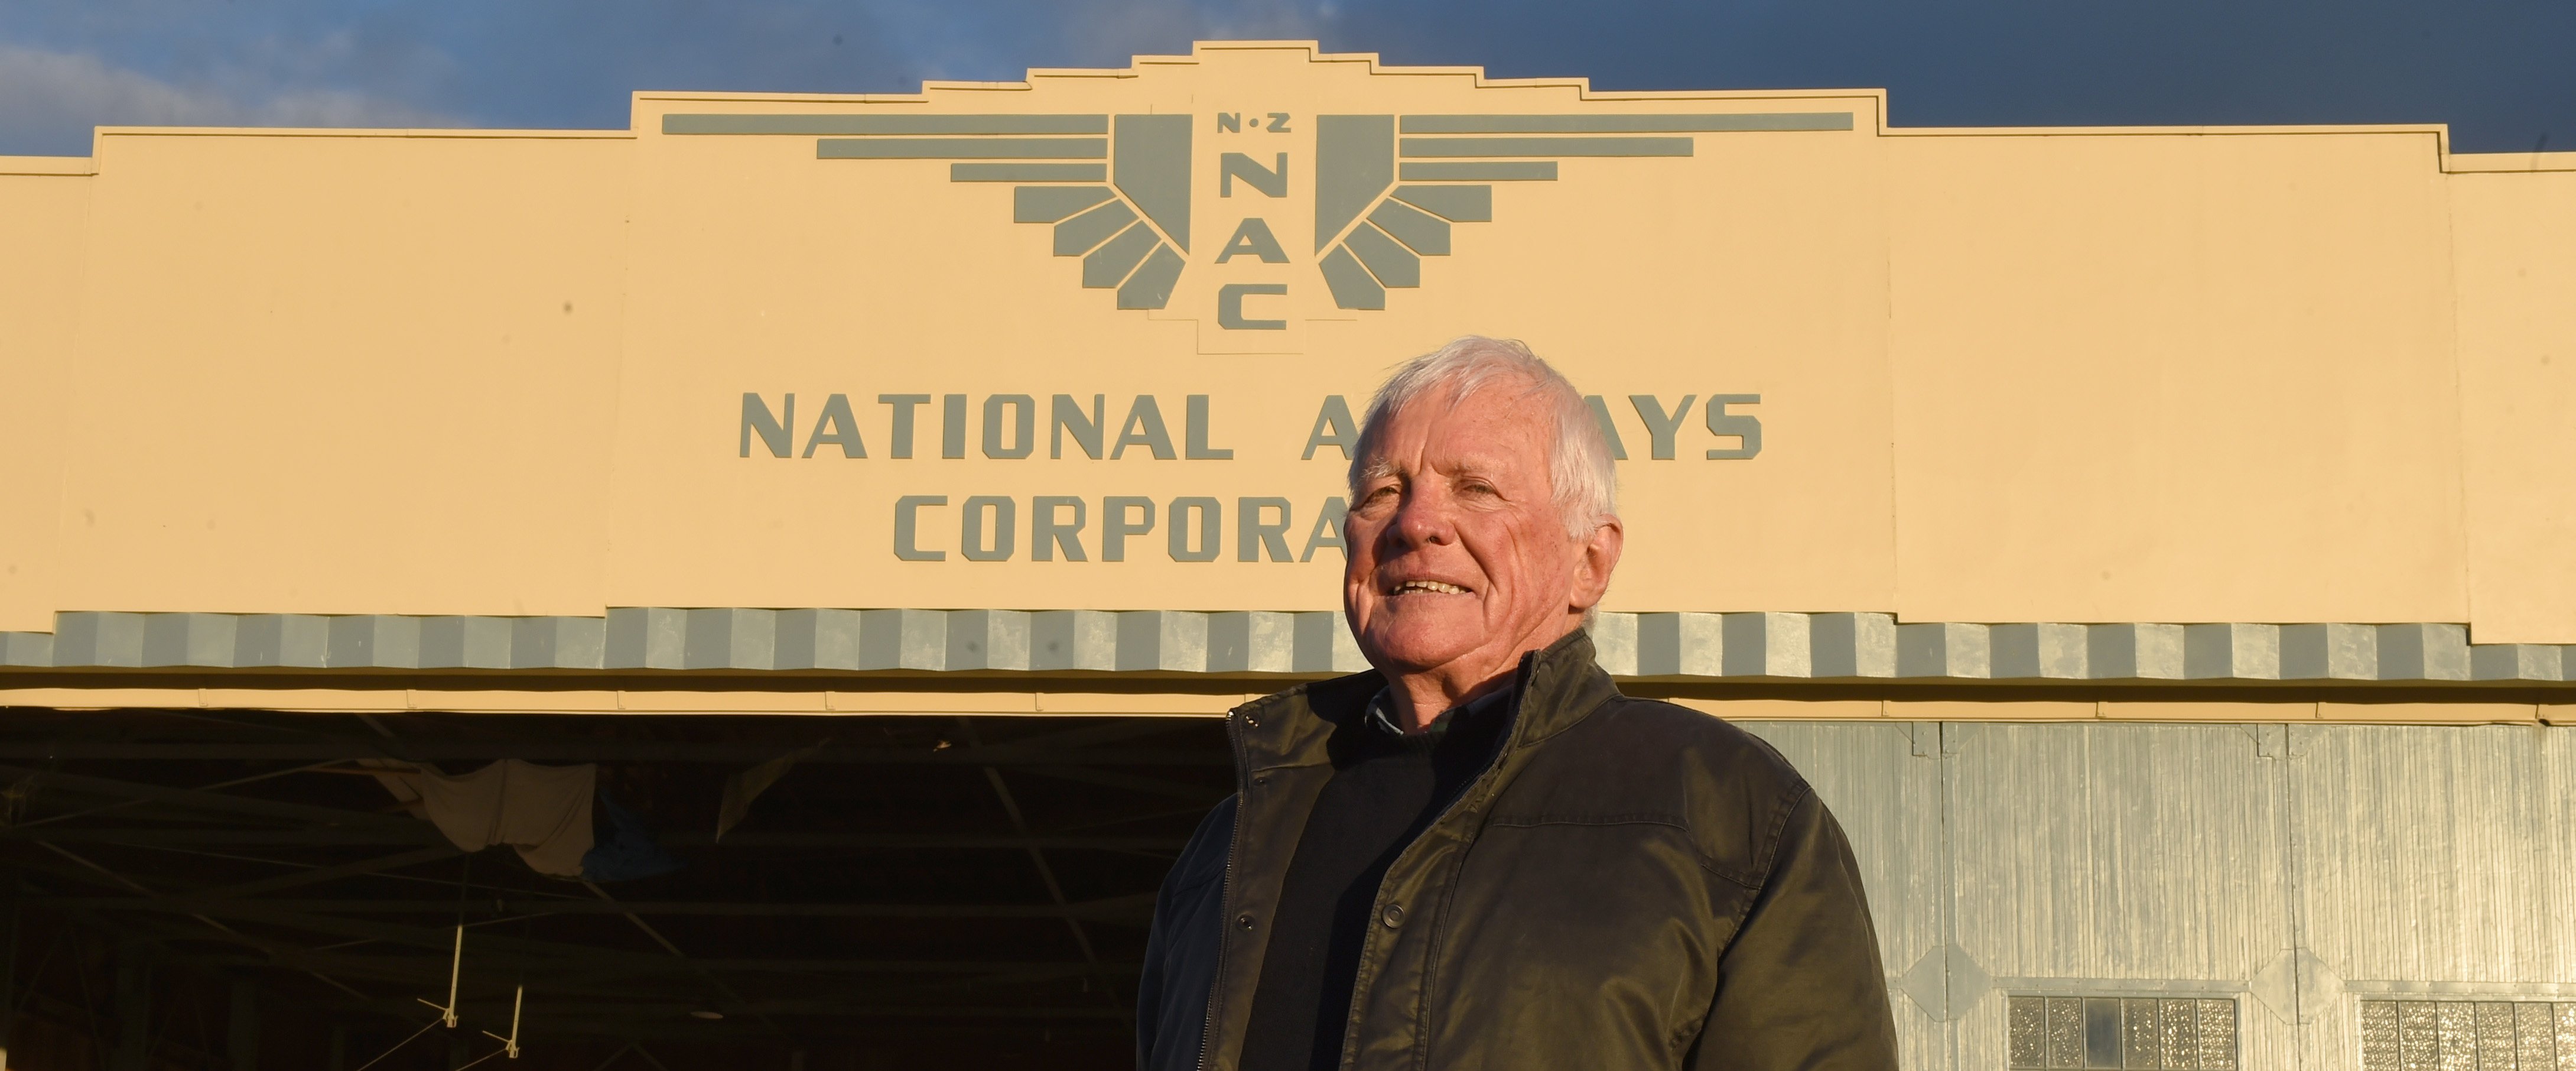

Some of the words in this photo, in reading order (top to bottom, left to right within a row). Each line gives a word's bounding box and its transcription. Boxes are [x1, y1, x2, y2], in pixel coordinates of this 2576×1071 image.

[1214, 152, 1290, 330] NAC
[740, 392, 1234, 460] NATIONAL
[894, 495, 1348, 563] CORPORA
